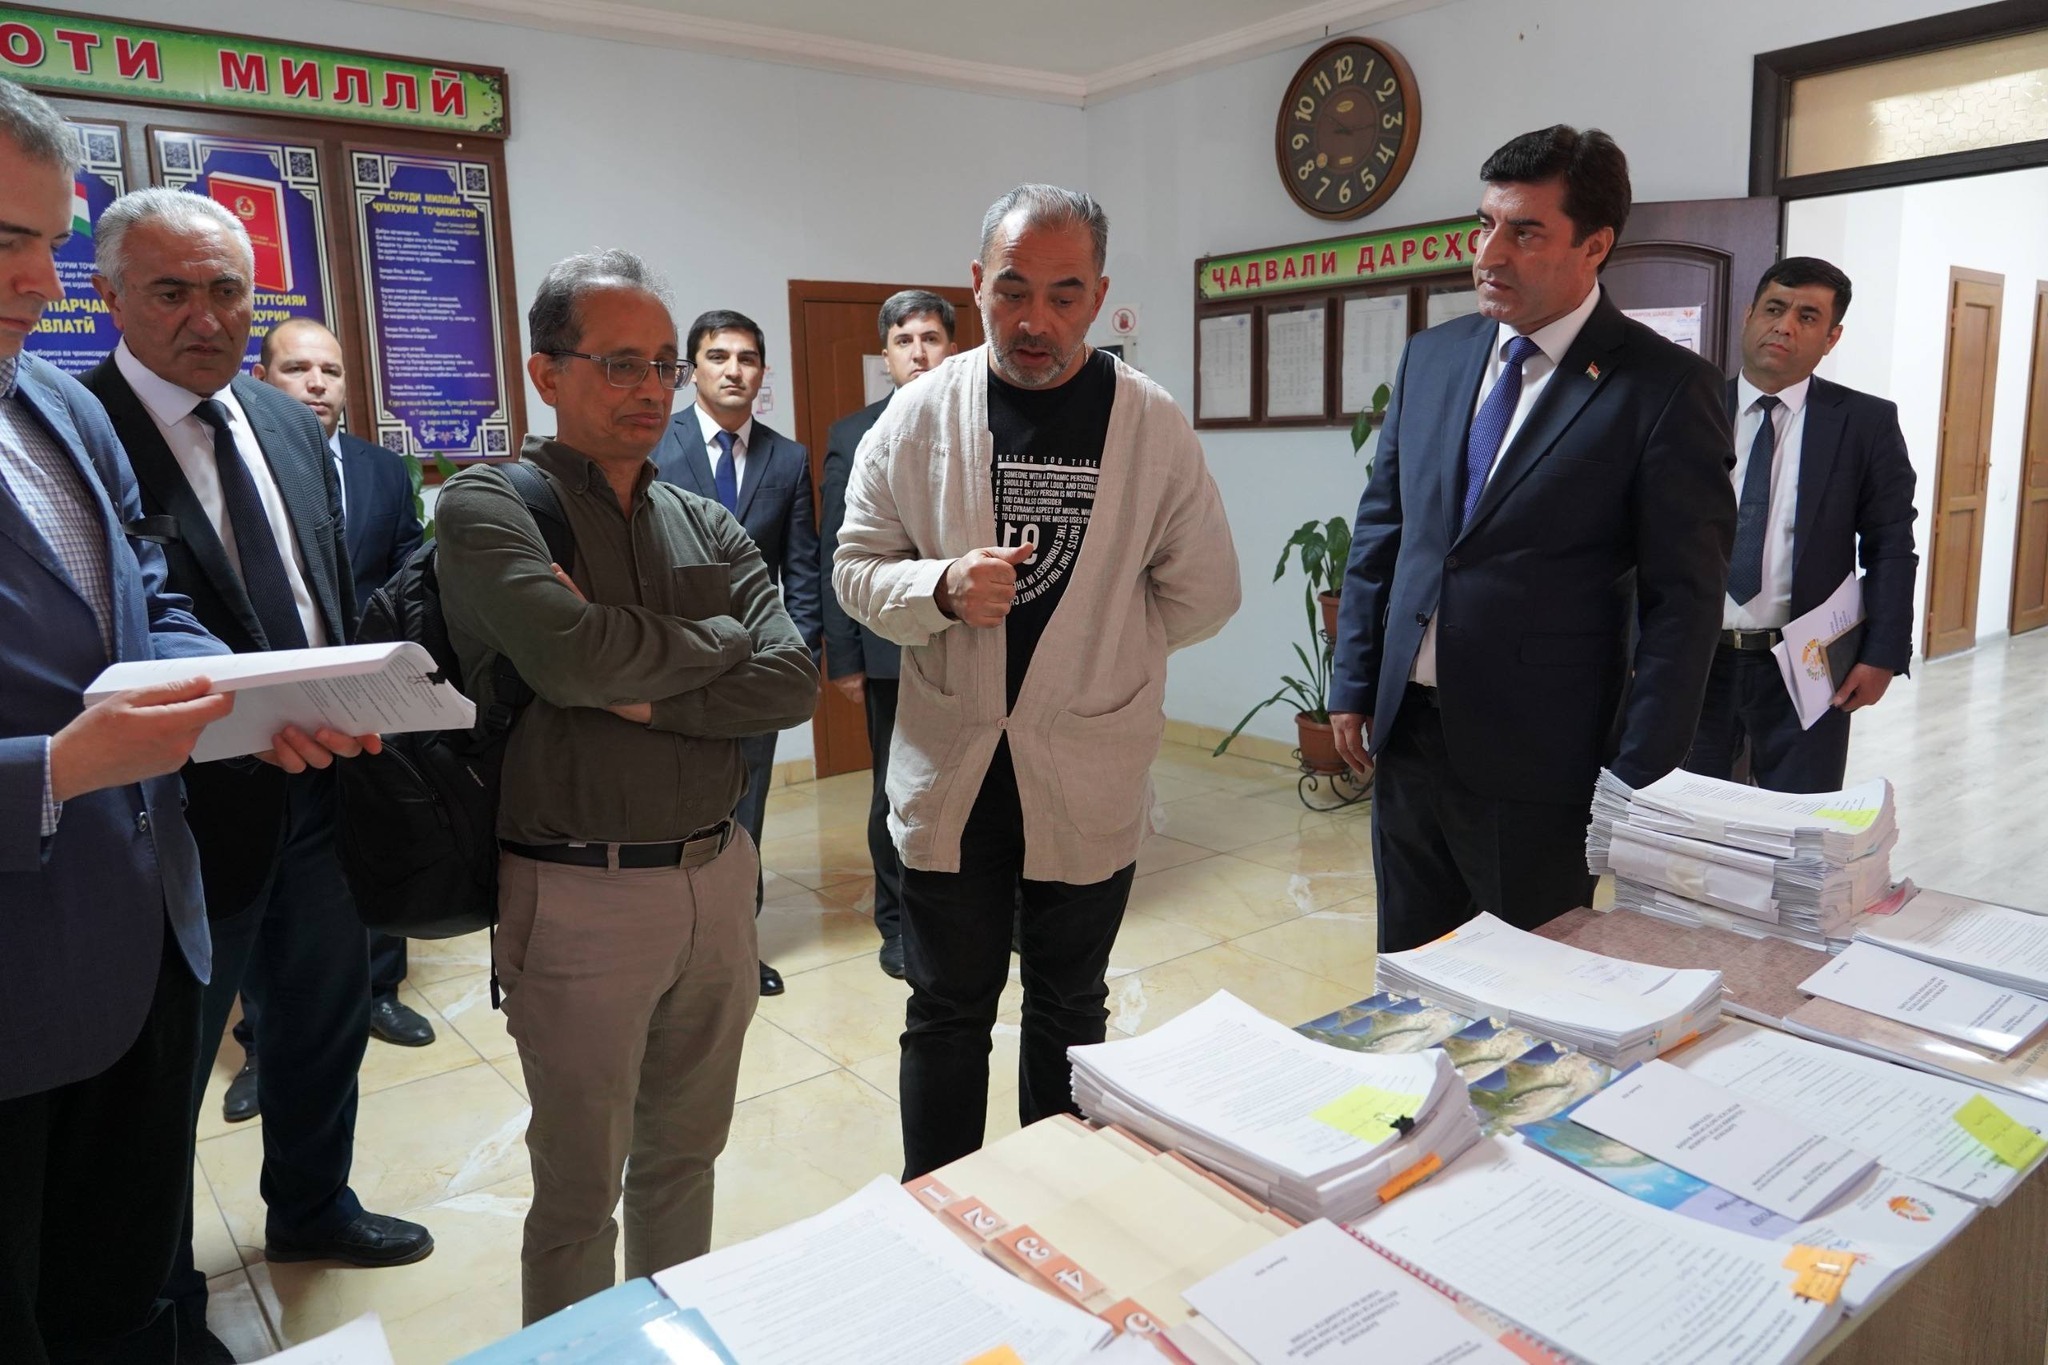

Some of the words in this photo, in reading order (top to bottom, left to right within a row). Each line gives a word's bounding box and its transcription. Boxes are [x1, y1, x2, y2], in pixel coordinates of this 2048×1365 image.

[1334, 55, 1354, 84] 12
[1362, 58, 1375, 84] 1
[218, 49, 467, 119] МИЛЛӢ
[1312, 70, 1332, 96] 11
[1375, 77, 1396, 102] 2
[1294, 95, 1315, 122] 10
[1382, 111, 1403, 129] 3
[1291, 133, 1310, 150] 9
[1376, 143, 1396, 164] 4
[1298, 159, 1315, 180] 8
[1360, 167, 1376, 192] 5
[1314, 176, 1331, 200] 7
[1338, 179, 1352, 204] 6
[1212, 251, 1337, 291] ҶАДВАЛИ
[28, 316, 96, 335] АВЛАТӢ
[998, 454, 1034, 462] NEVER
[1043, 456, 1063, 464] TOO
[1004, 471, 1028, 479] SOMEONE
[1029, 472, 1042, 480] WITH
[1047, 473, 1069, 481] DYNAMIC
[1066, 482, 1076, 490] AND
[1040, 489, 1059, 497] PERSON
[1066, 490, 1076, 498] NOT
[1013, 505, 1034, 513] DYNAMIC
[1035, 506, 1054, 514] ASPECT
[1056, 524, 1067, 540] THE
[1067, 525, 1080, 550] FACTS
[1034, 540, 1063, 579] STRONGEST
[1058, 550, 1074, 570] THAT
[1026, 574, 1036, 585] IN
[1047, 568, 1063, 584] YOU
[1021, 590, 1036, 604] NOT
[1035, 580, 1050, 596] CAN
[919, 1184, 950, 1204] 1
[962, 1206, 997, 1231] 2
[1015, 1236, 1050, 1260] 3
[1055, 1268, 1085, 1293] 4
